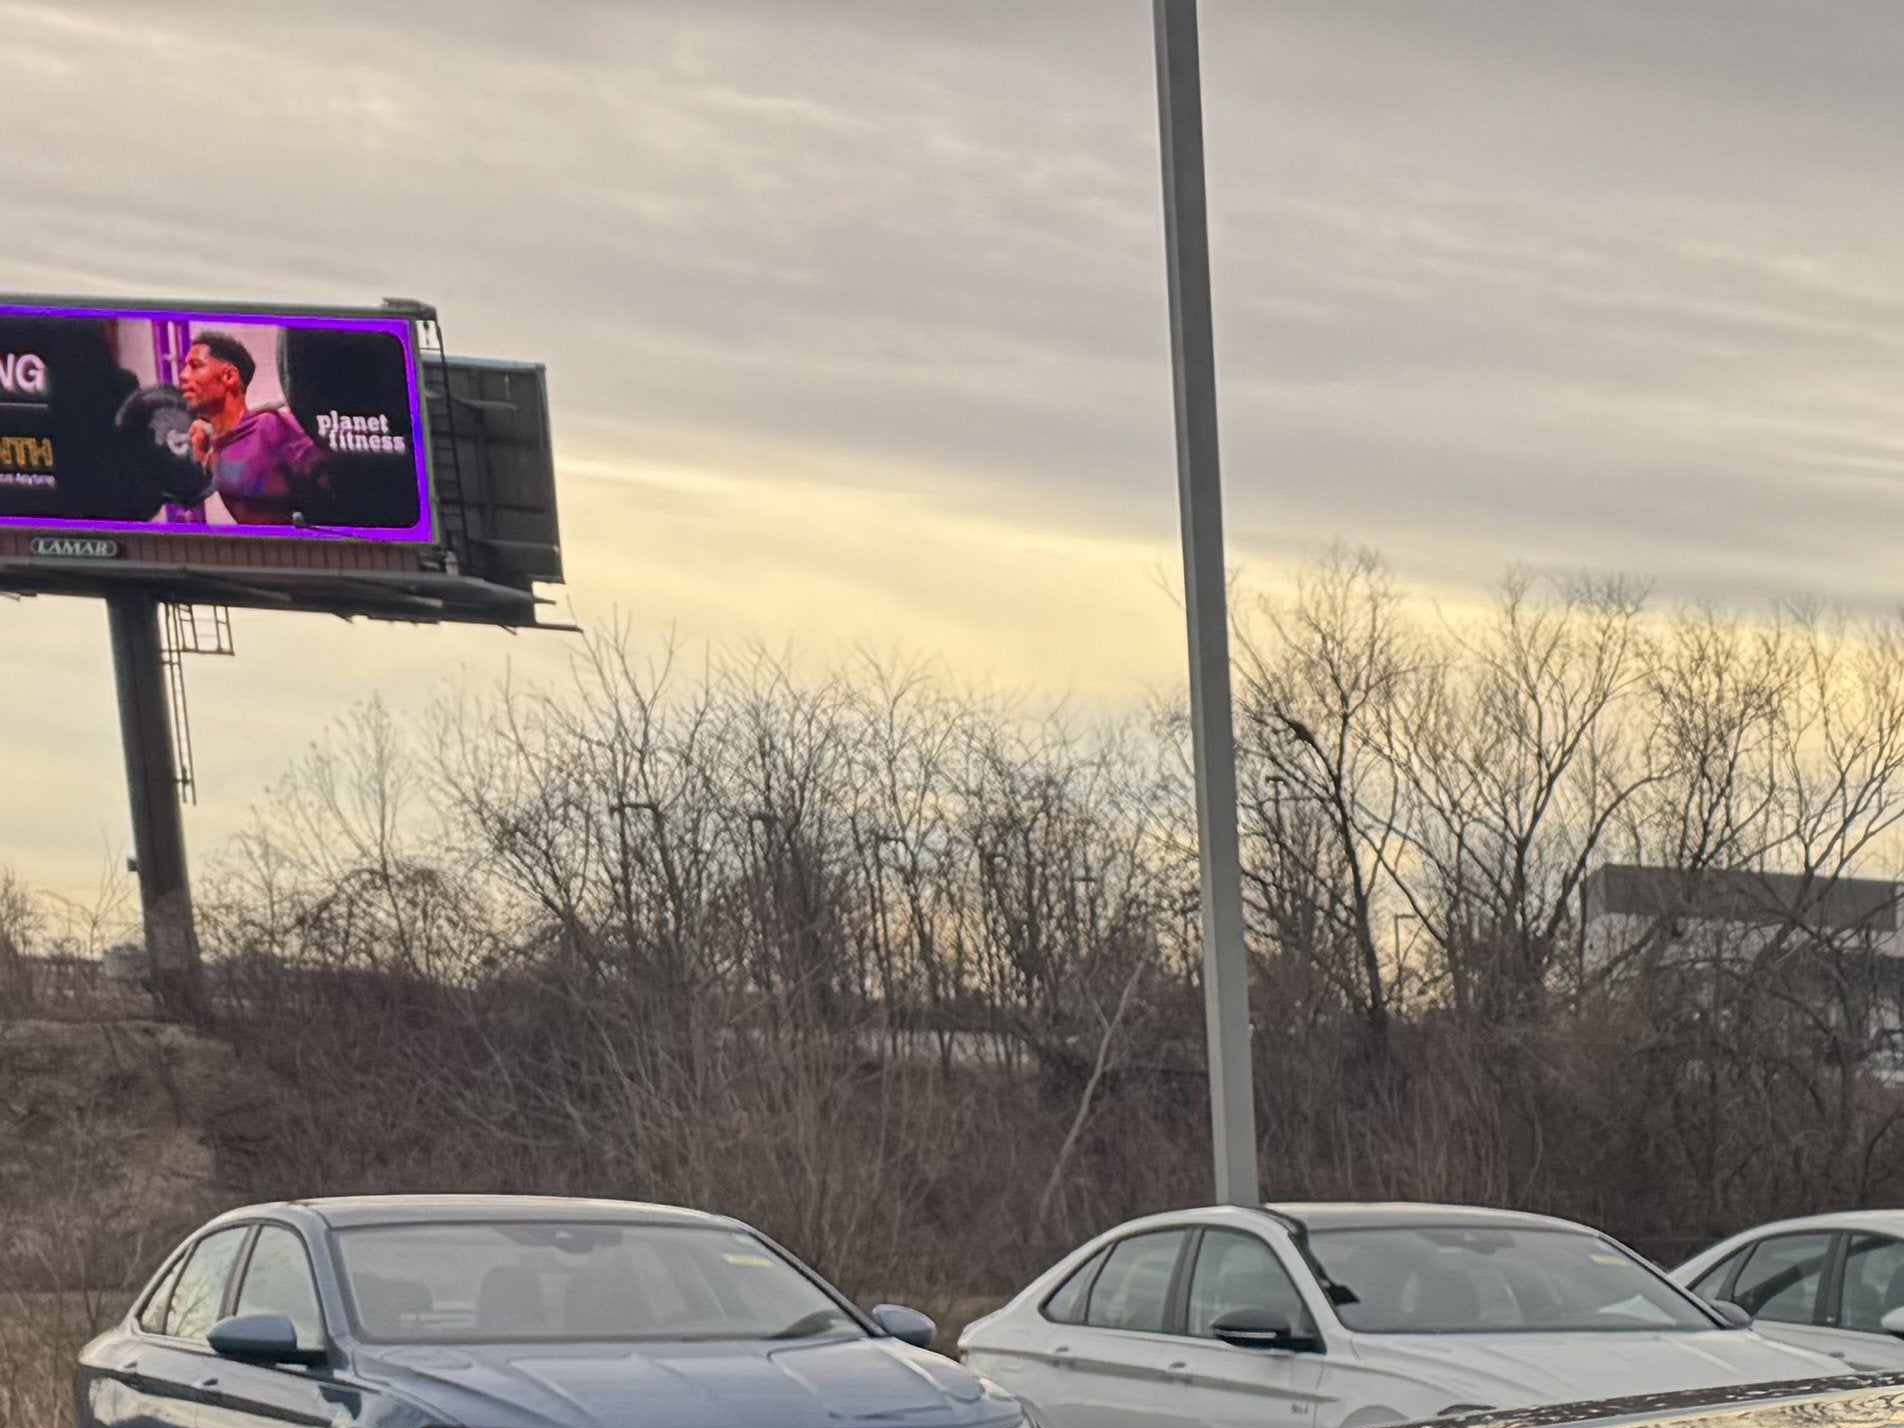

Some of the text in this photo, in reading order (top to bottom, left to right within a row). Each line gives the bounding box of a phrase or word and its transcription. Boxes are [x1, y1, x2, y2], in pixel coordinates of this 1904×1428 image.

[316, 409, 388, 437] planet
[329, 428, 406, 454] fitness
[37, 540, 108, 556] LAMAR
